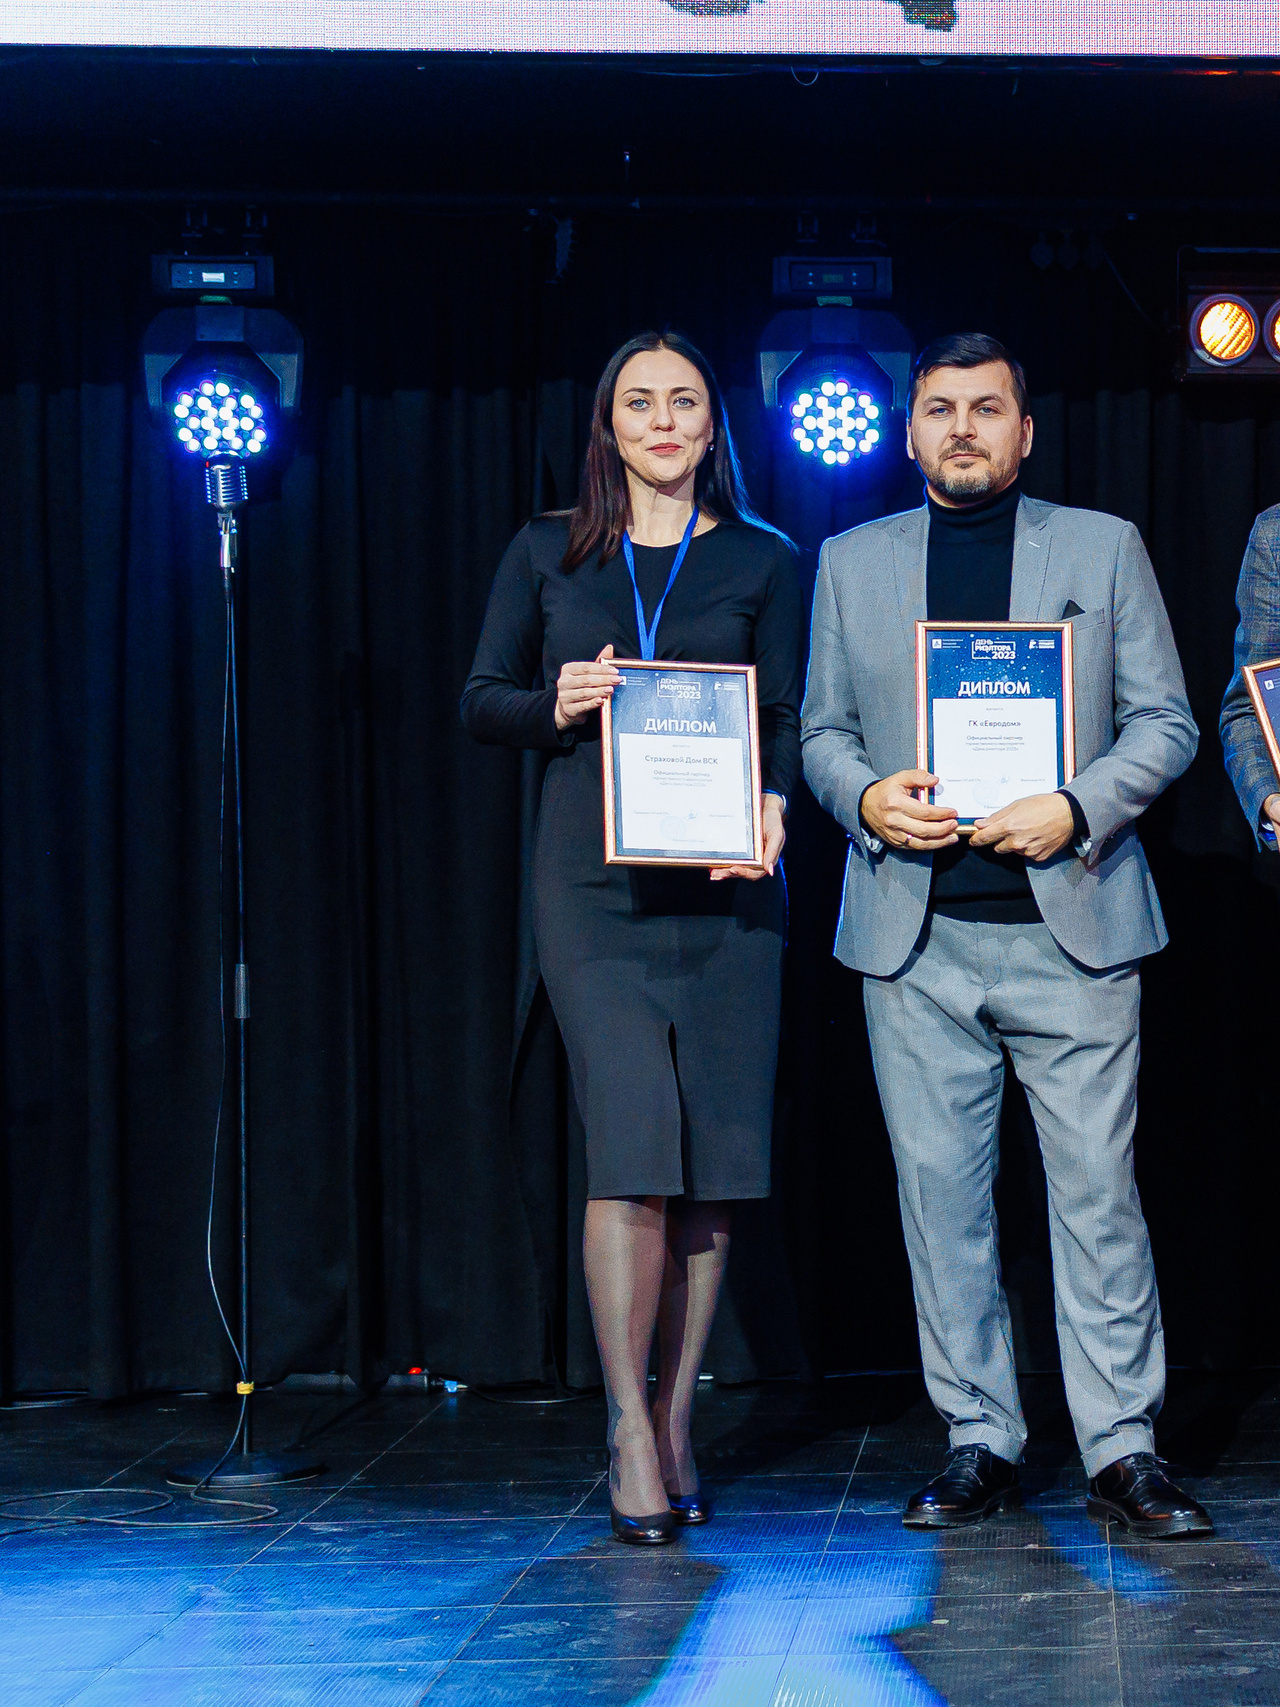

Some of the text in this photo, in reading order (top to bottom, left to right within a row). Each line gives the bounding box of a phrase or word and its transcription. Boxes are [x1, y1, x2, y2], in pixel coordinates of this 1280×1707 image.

[991, 651, 1016, 660] 2023
[957, 681, 1031, 697] ДИПЛОМ
[677, 690, 701, 699] 2023
[643, 718, 717, 734] ДИПЛОМ
[968, 719, 1021, 728] ГК «Евродом»
[644, 755, 718, 765] Страховой Дом ВСК
